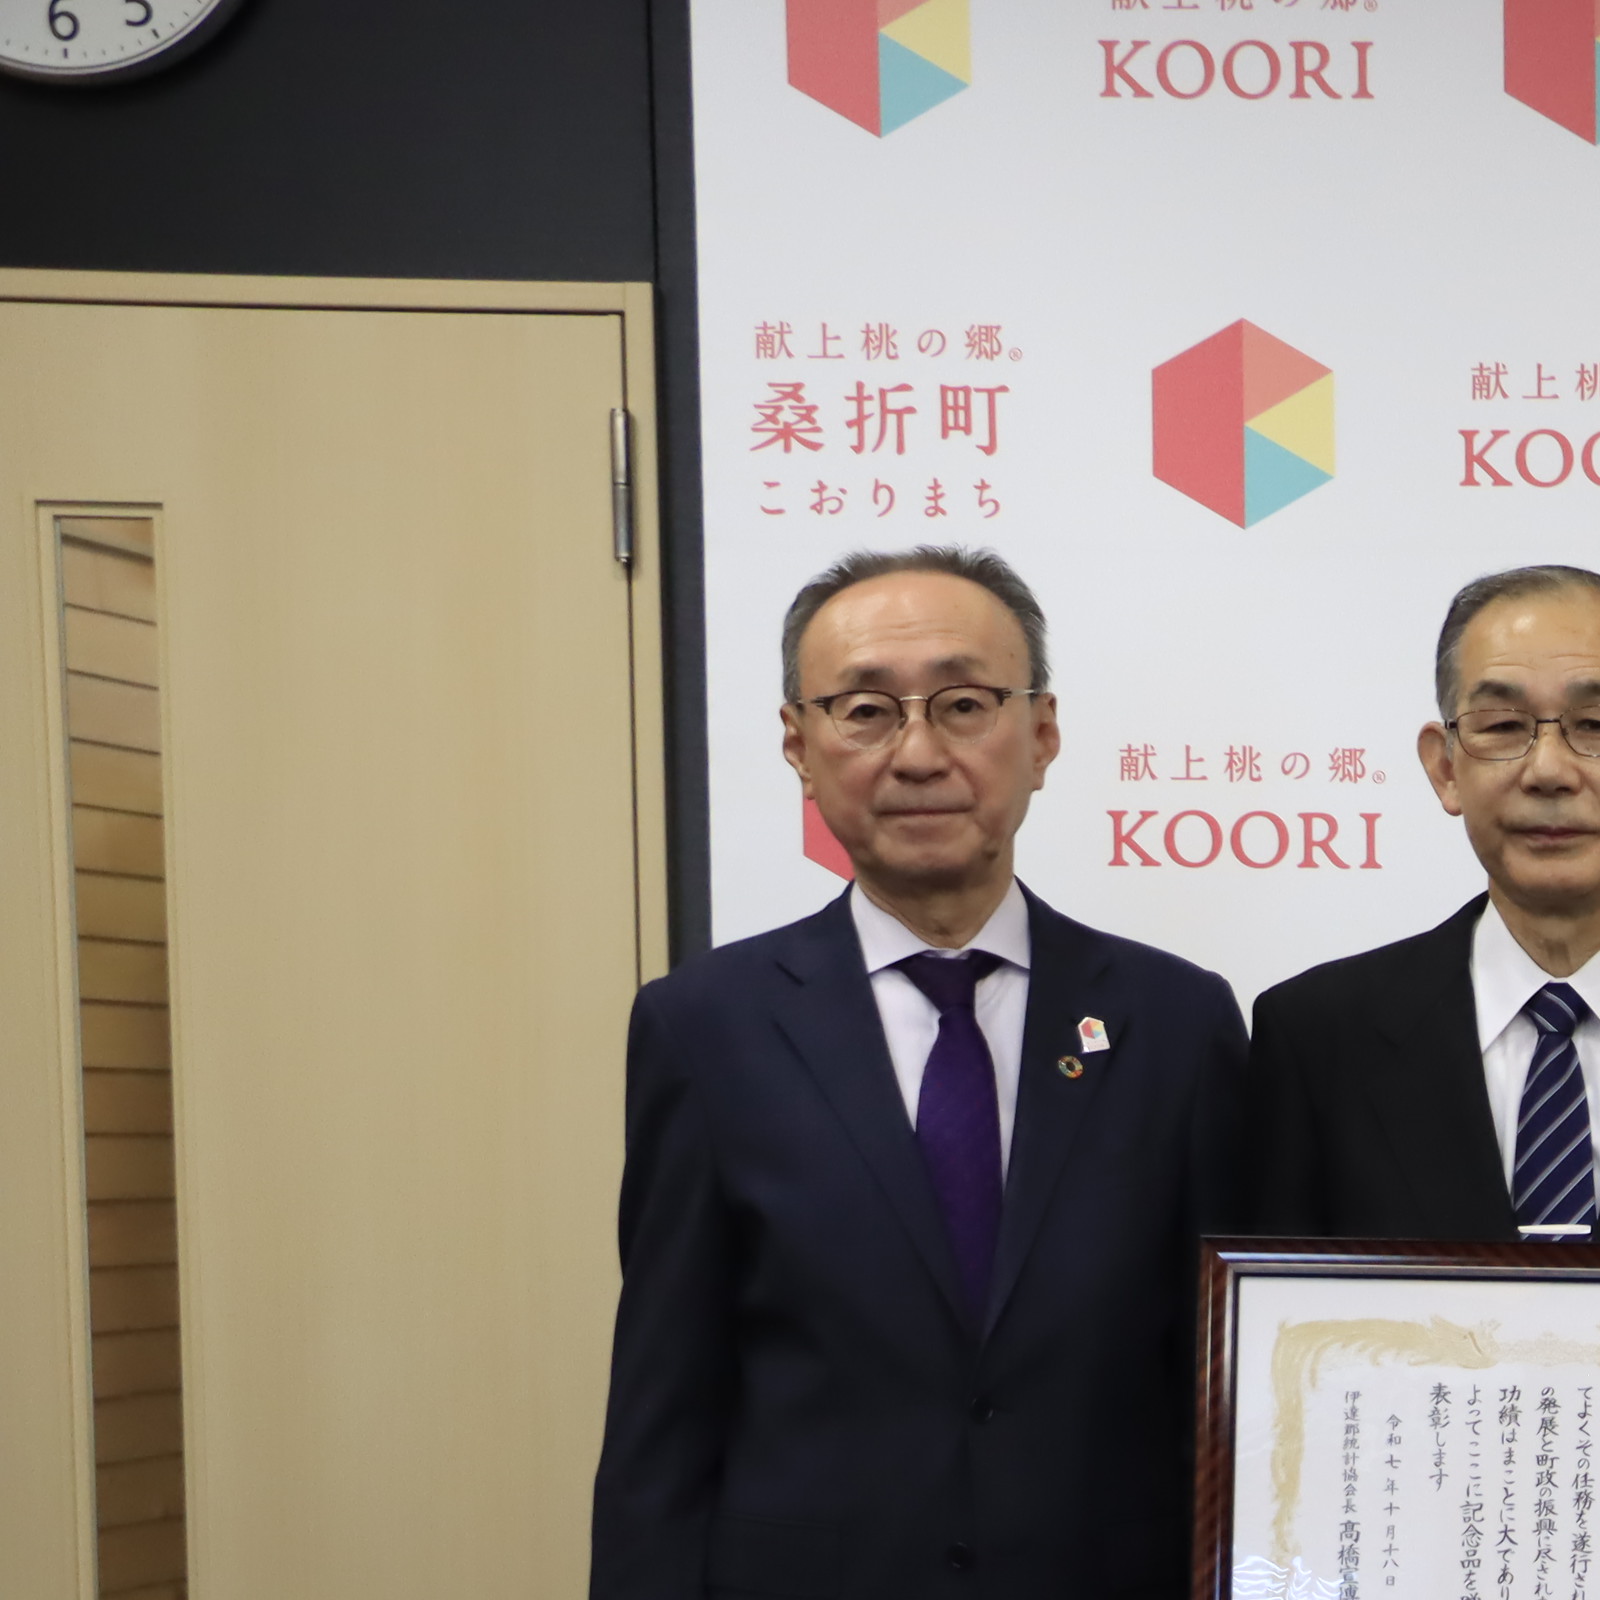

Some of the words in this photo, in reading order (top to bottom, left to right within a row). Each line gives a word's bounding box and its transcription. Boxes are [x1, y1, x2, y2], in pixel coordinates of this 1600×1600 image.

[48, 0, 79, 41] 6
[1099, 40, 1375, 100] KOORI
[751, 381, 1010, 456] 桑折町
[761, 479, 1000, 518] こおりまち
[1106, 810, 1383, 869] KOORI
[1427, 1382, 1453, 1492] 表彰します
[1382, 1414, 1403, 1587] 令和七年十月十八日
